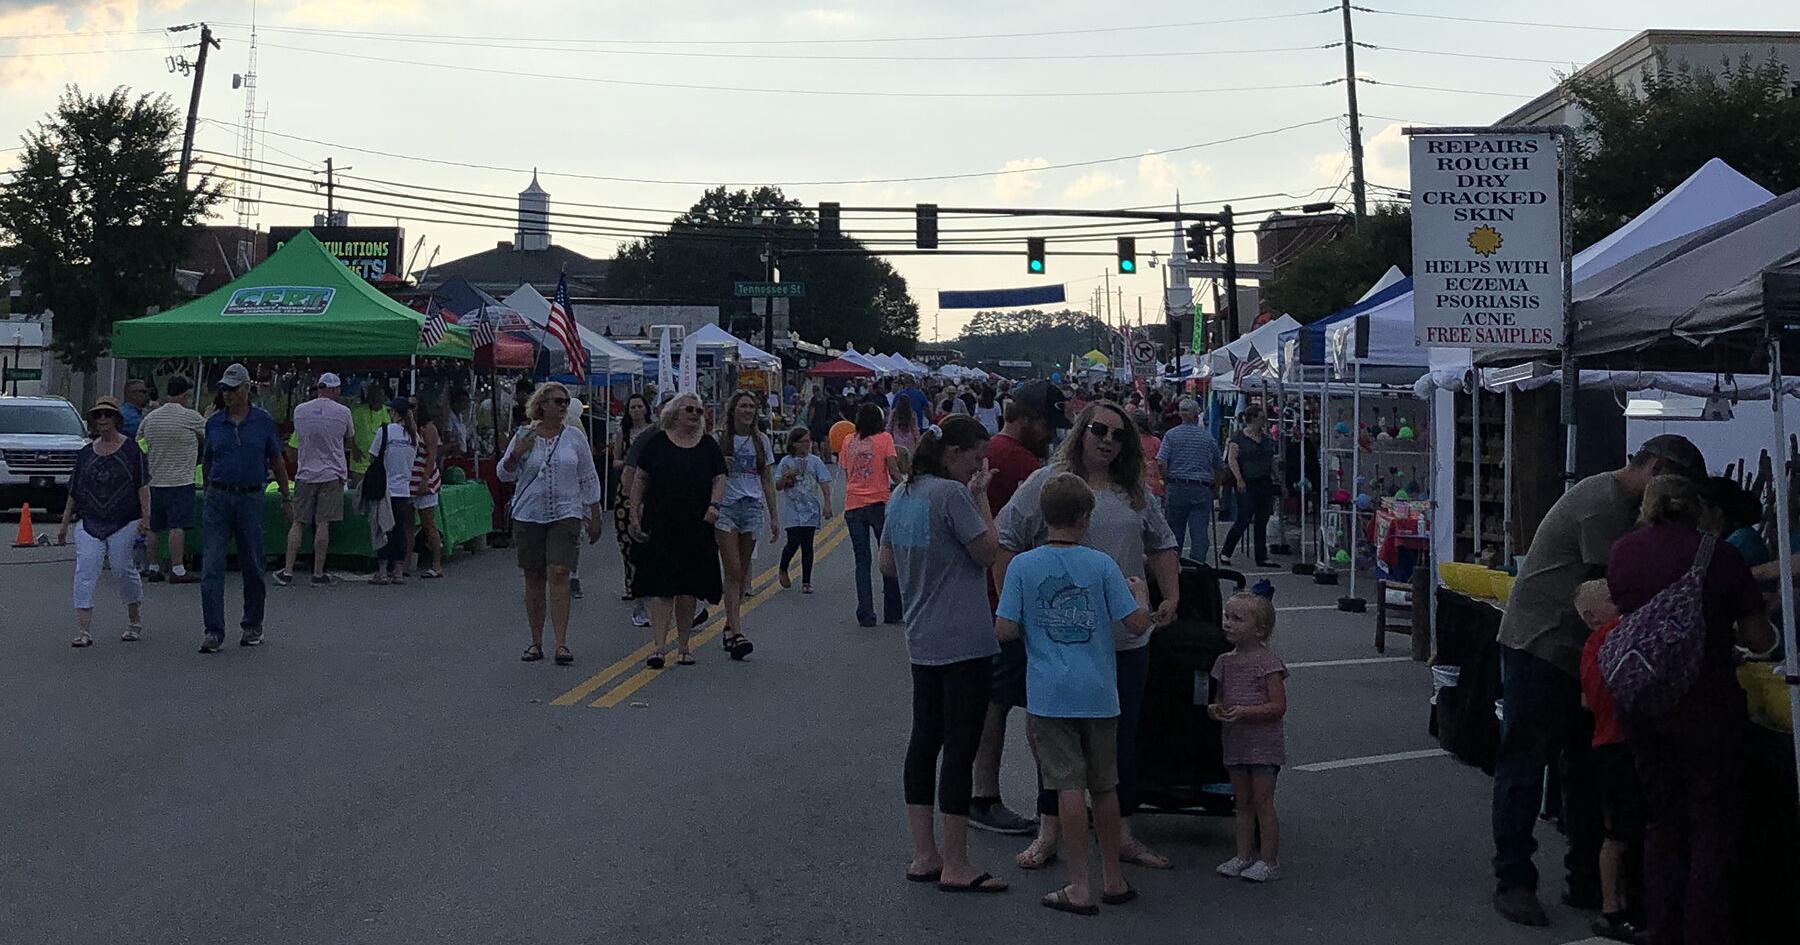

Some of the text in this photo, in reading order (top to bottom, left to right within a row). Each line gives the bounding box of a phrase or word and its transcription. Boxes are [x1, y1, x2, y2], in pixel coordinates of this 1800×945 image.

[1428, 140, 1538, 154] REPAIRS
[1437, 157, 1529, 171] ROUGH
[1456, 174, 1509, 188] DRY
[1422, 191, 1547, 205] CRACKED
[1454, 208, 1515, 221] SKIN
[1425, 260, 1549, 274] HELPS WITH
[738, 284, 801, 294] Tennessee St
[1445, 277, 1529, 291] ECZEMA
[1436, 295, 1540, 309] PSORIASIS
[1461, 312, 1516, 326] ACNE
[1427, 327, 1552, 344] FREE SAMPLES
